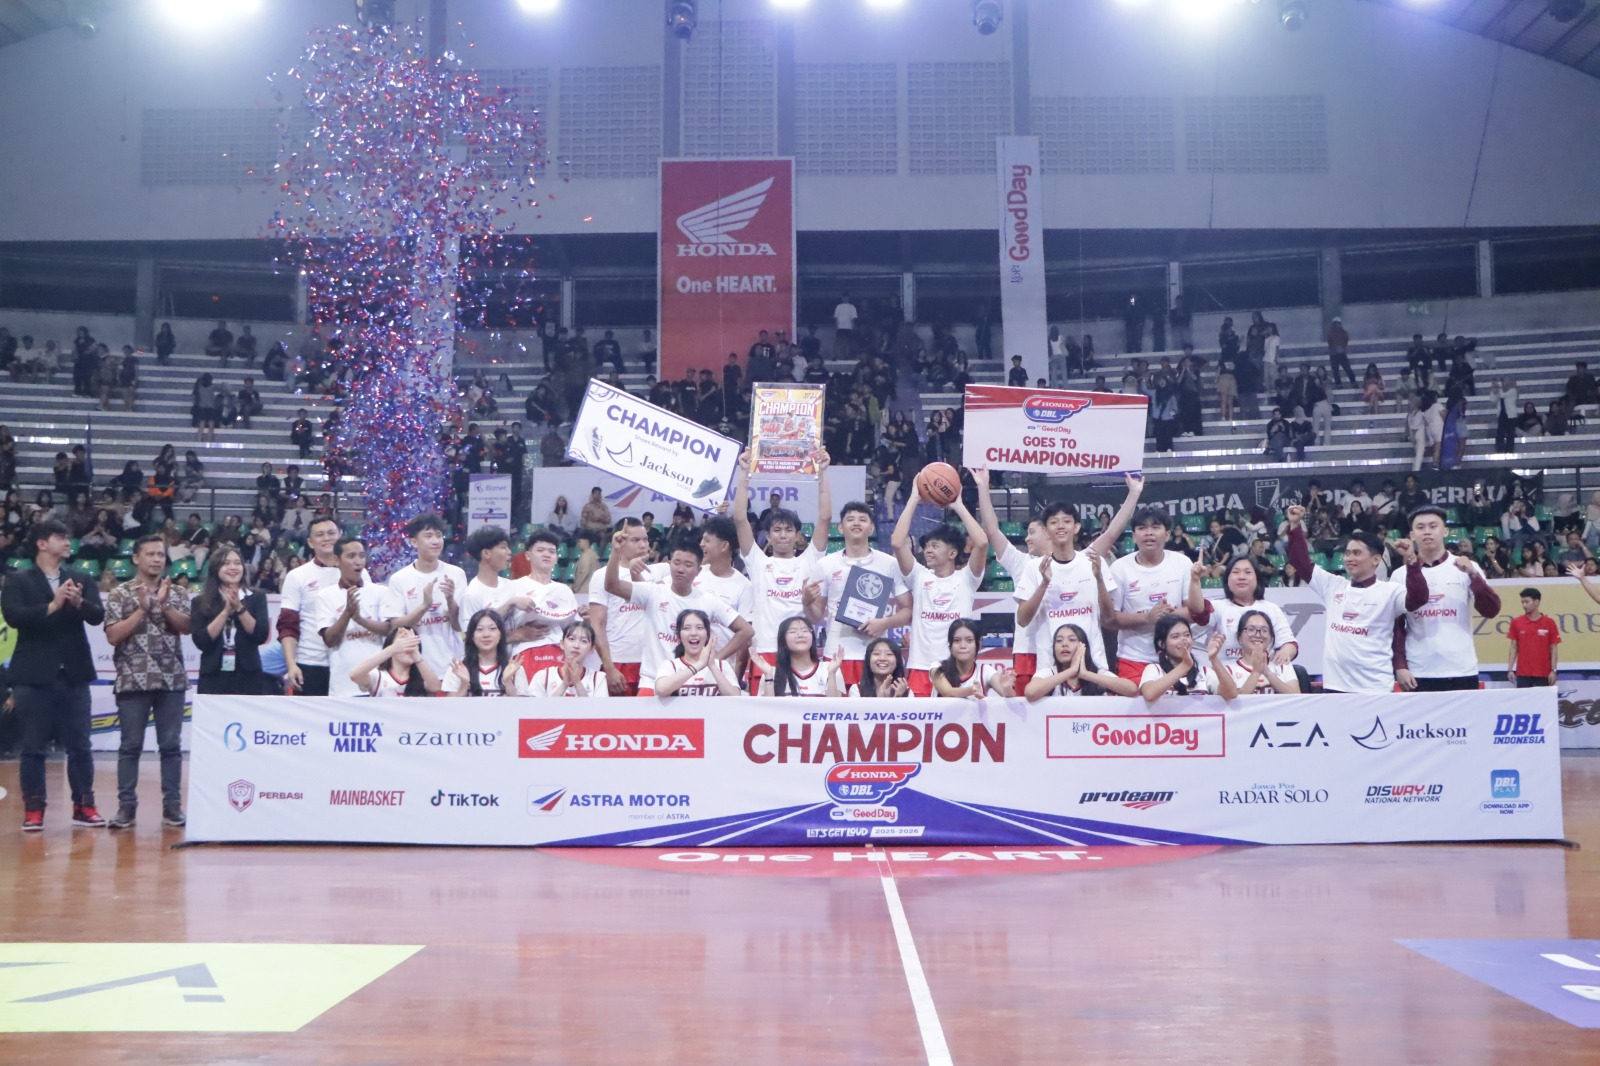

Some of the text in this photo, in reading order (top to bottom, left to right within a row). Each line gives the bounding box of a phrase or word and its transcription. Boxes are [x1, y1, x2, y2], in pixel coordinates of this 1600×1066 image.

[676, 243, 777, 257] HONDA
[676, 275, 777, 293] One HEART.
[759, 402, 815, 416] CHAMPION
[1041, 401, 1075, 409] HONDA
[1040, 410, 1057, 418] DBL
[606, 404, 722, 463] CHAMPION
[1022, 435, 1077, 449] GOES TO
[985, 446, 1120, 470] CHAMPIONSHIP
[639, 455, 694, 487] Jackson
[1119, 493, 1245, 516] TORIA
[619, 603, 645, 613] CHAM
[1048, 605, 1093, 619] CHAMPION
[1412, 608, 1457, 620] CHAMPION
[920, 611, 961, 621] CHAMPION
[802, 711, 944, 721] CENTRAL JAVA-SOUTH
[328, 722, 384, 737] ULTRA
[1493, 713, 1545, 736] DBL
[254, 730, 308, 746] Biznet
[1395, 723, 1468, 741] Jackson
[333, 737, 378, 753] MILK
[564, 733, 697, 751] HONDA
[743, 722, 1006, 764] CHAMPION
[1493, 736, 1546, 745] INDONESIA
[850, 771, 899, 779] HONDA
[1494, 777, 1517, 787] DBL
[849, 784, 874, 796] DBL
[1250, 782, 1296, 790] Jawa Pos
[1366, 784, 1444, 797] DISWAY.ID
[258, 791, 304, 800] PERBASI
[329, 790, 406, 807] MAINBASKET
[447, 793, 500, 807] TikTok
[569, 794, 691, 807] ASTRA MOTOR
[1078, 789, 1175, 805] proteam
[1218, 789, 1329, 804] RADAR SOLO
[1364, 795, 1441, 804] NATIONAL NETWORK
[657, 850, 1104, 863] One HEART.
